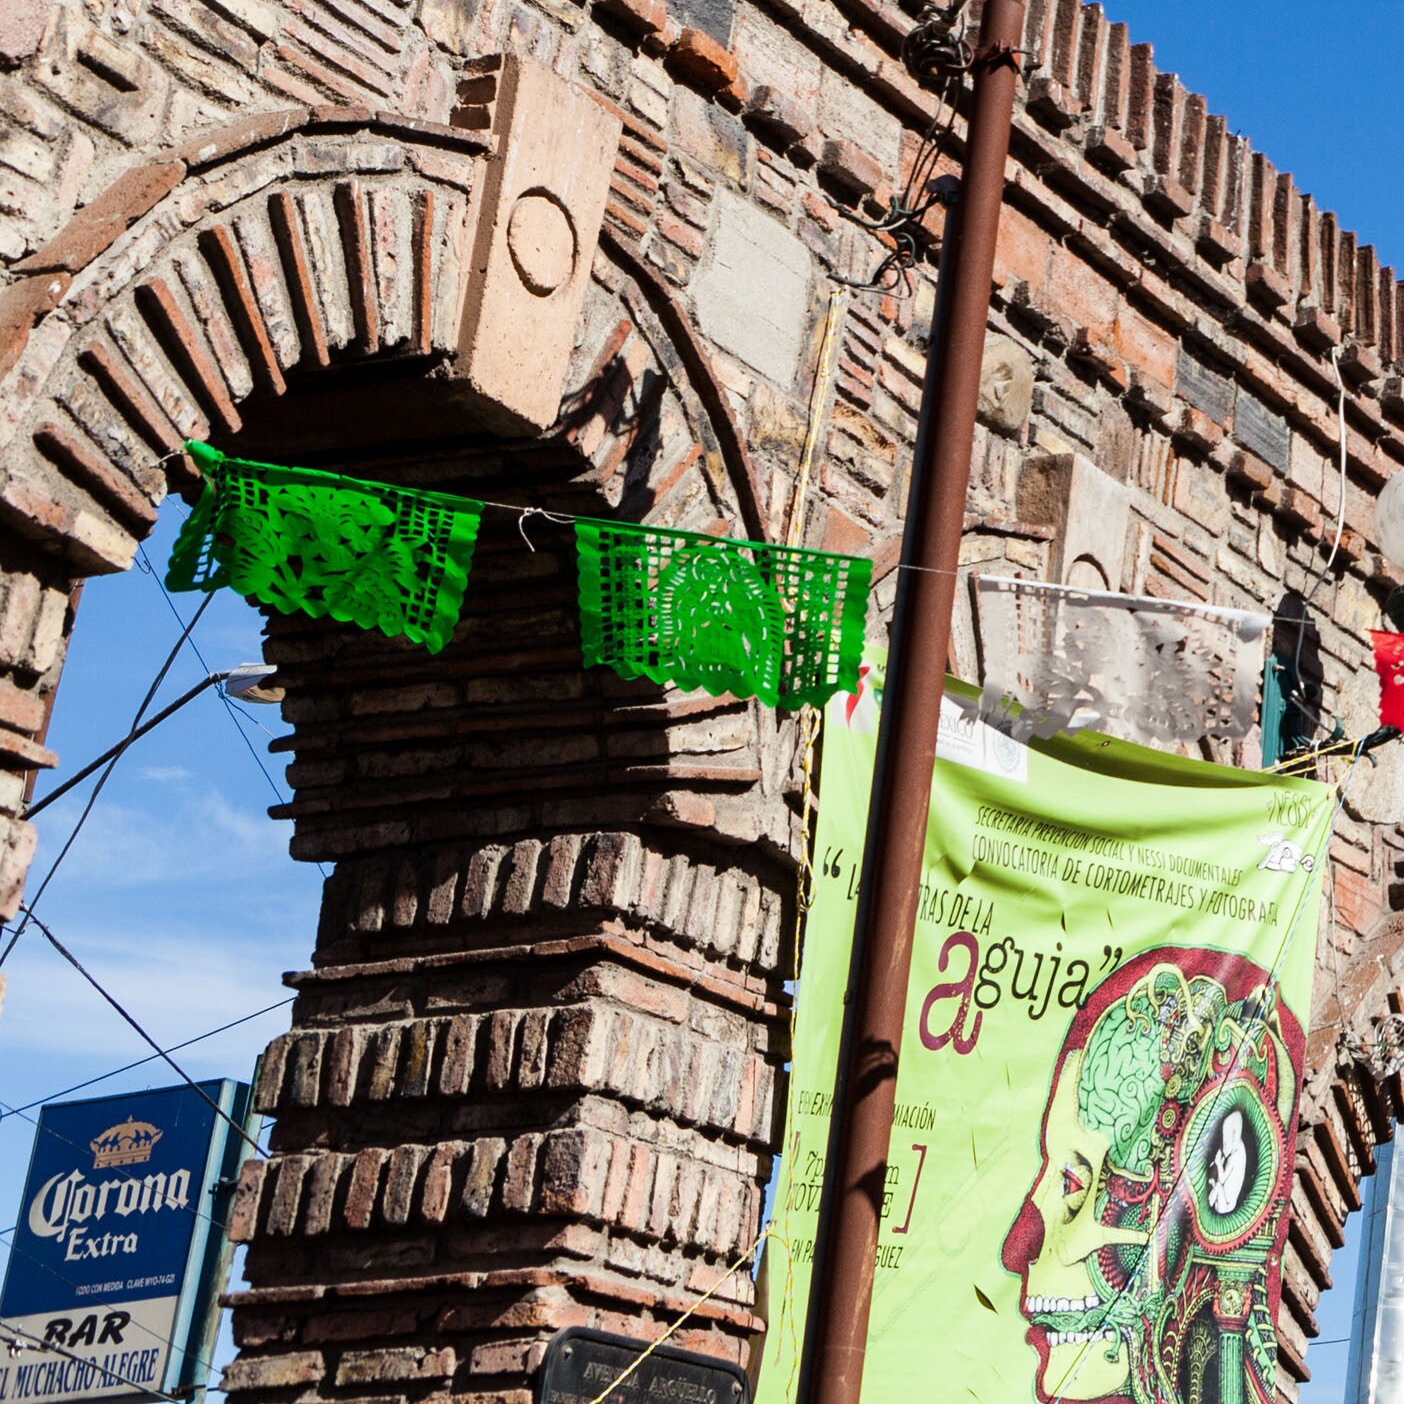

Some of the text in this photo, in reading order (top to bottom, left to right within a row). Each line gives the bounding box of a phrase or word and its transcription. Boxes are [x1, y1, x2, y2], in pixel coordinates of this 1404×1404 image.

[975, 805, 1243, 887] SECRETARIA PREVENCION SOCIAL Y NESSI DOCUMENTALES
[972, 834, 1060, 880] CONVOCATORIA
[1062, 857, 1082, 885] DE
[1085, 862, 1194, 909] CORTOMETRAJES
[1199, 888, 1208, 912] Y
[947, 892, 973, 931] DE
[972, 899, 995, 936] LA
[28, 1167, 192, 1243] Corona
[64, 1226, 139, 1263] Extra
[44, 1310, 131, 1348] BAR
[12, 1355, 97, 1399] MUCHACHO
[97, 1348, 160, 1389] ALEGRE
